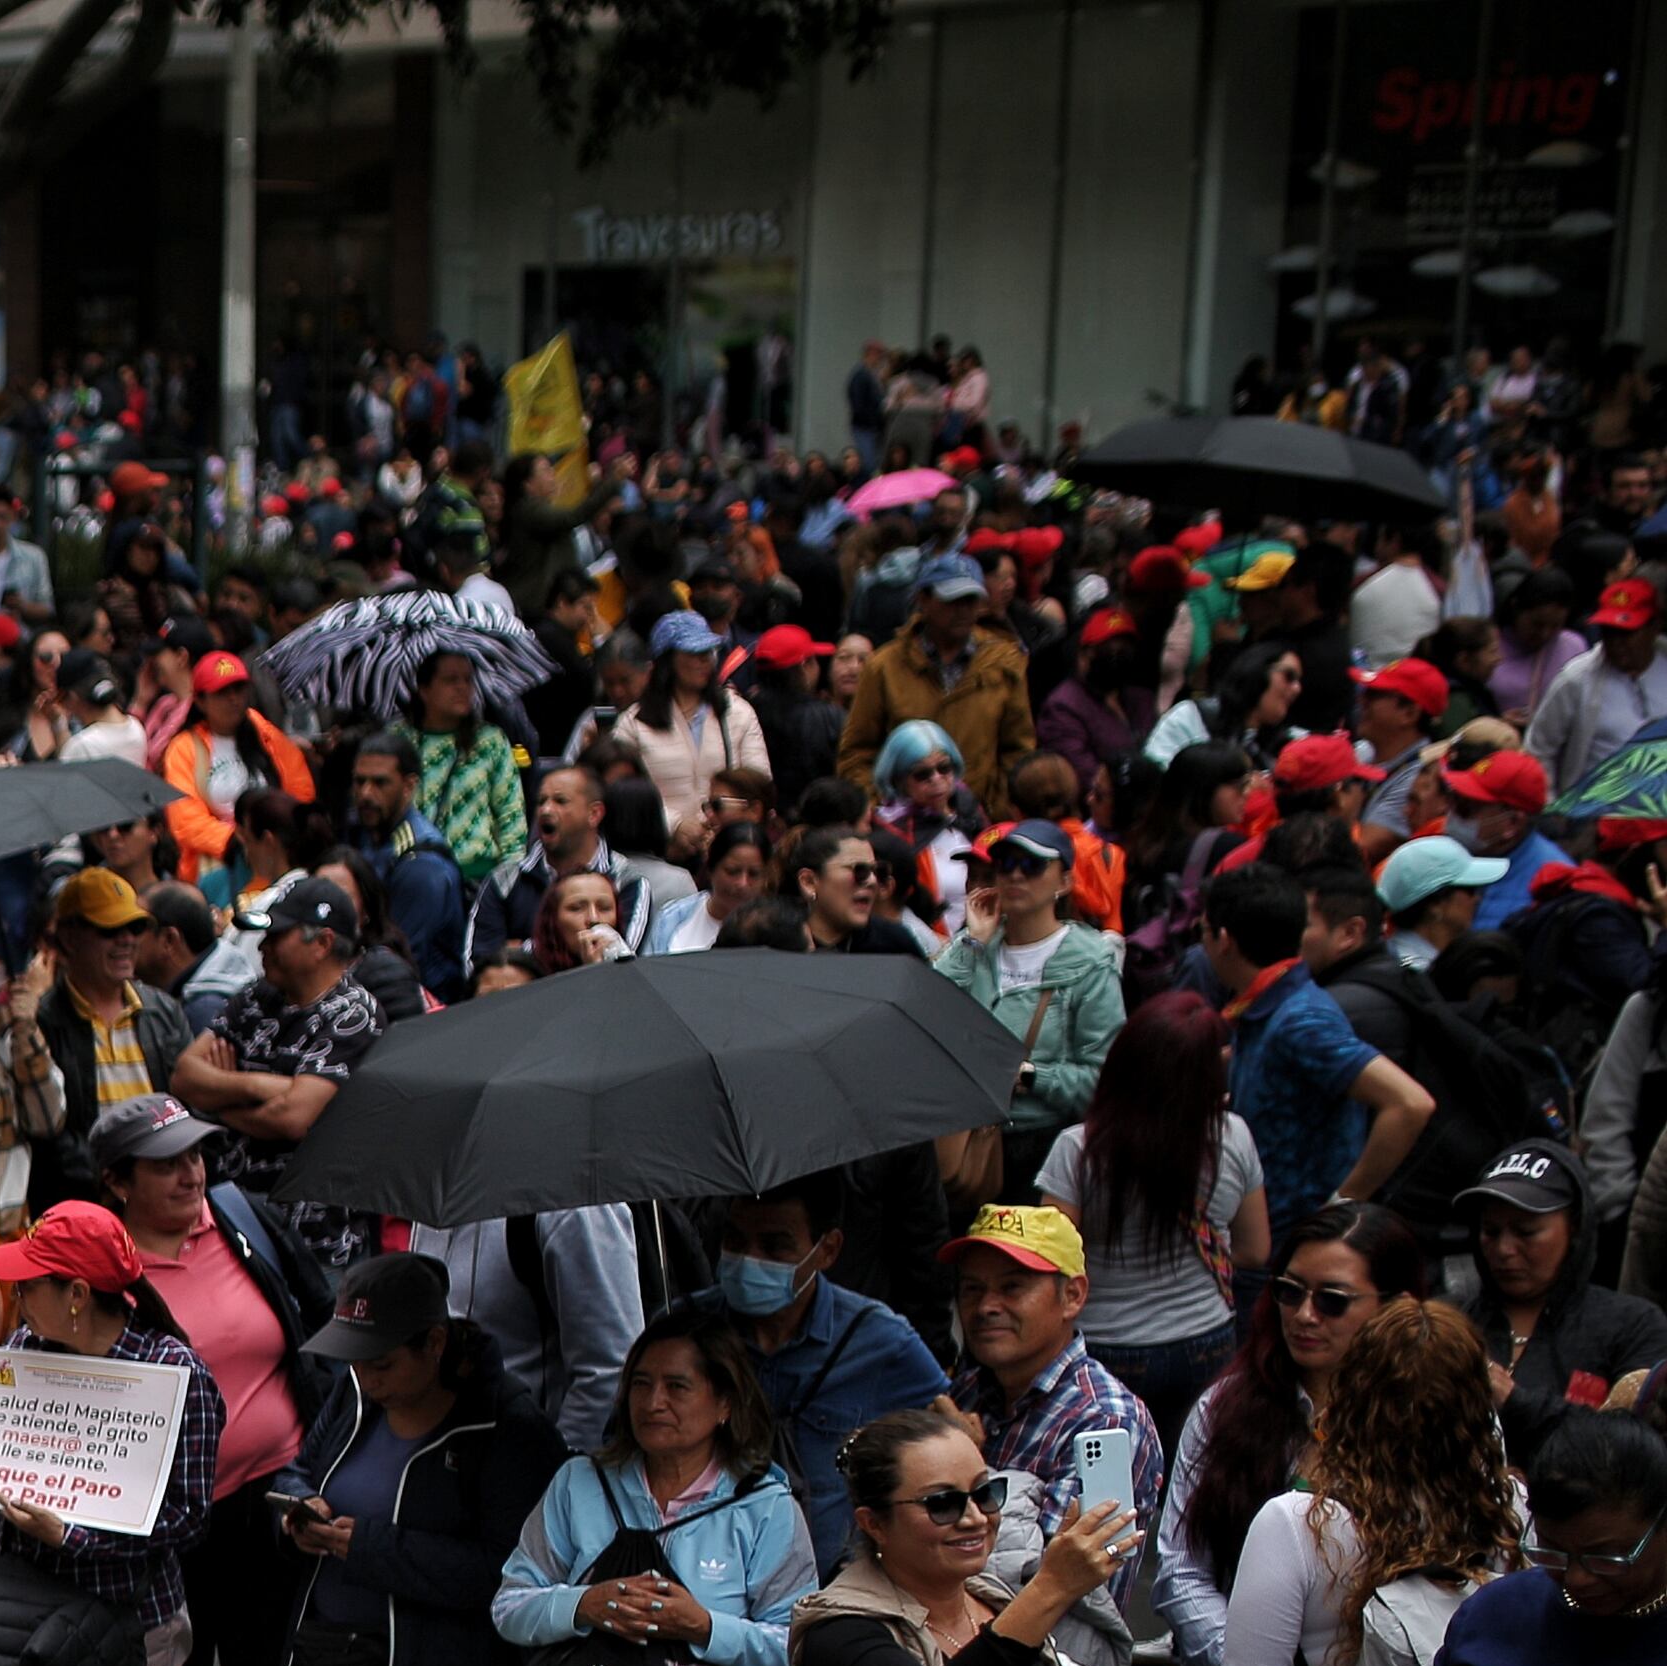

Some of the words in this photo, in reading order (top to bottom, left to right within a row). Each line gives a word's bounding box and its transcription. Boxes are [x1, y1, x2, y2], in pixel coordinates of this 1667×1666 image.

[11, 1412, 81, 1436] atiende,
[86, 1420, 102, 1437] el
[107, 1424, 148, 1445] grito
[42, 1399, 70, 1415] del
[74, 1404, 166, 1429] Magisterio
[2, 1427, 82, 1453] maestr@
[86, 1440, 109, 1454] en
[113, 1442, 129, 1458] la
[26, 1448, 46, 1462] se
[50, 1450, 108, 1473] siente.
[45, 1471, 64, 1490] el
[70, 1476, 122, 1499] Paro
[19, 1488, 77, 1512] Para!
